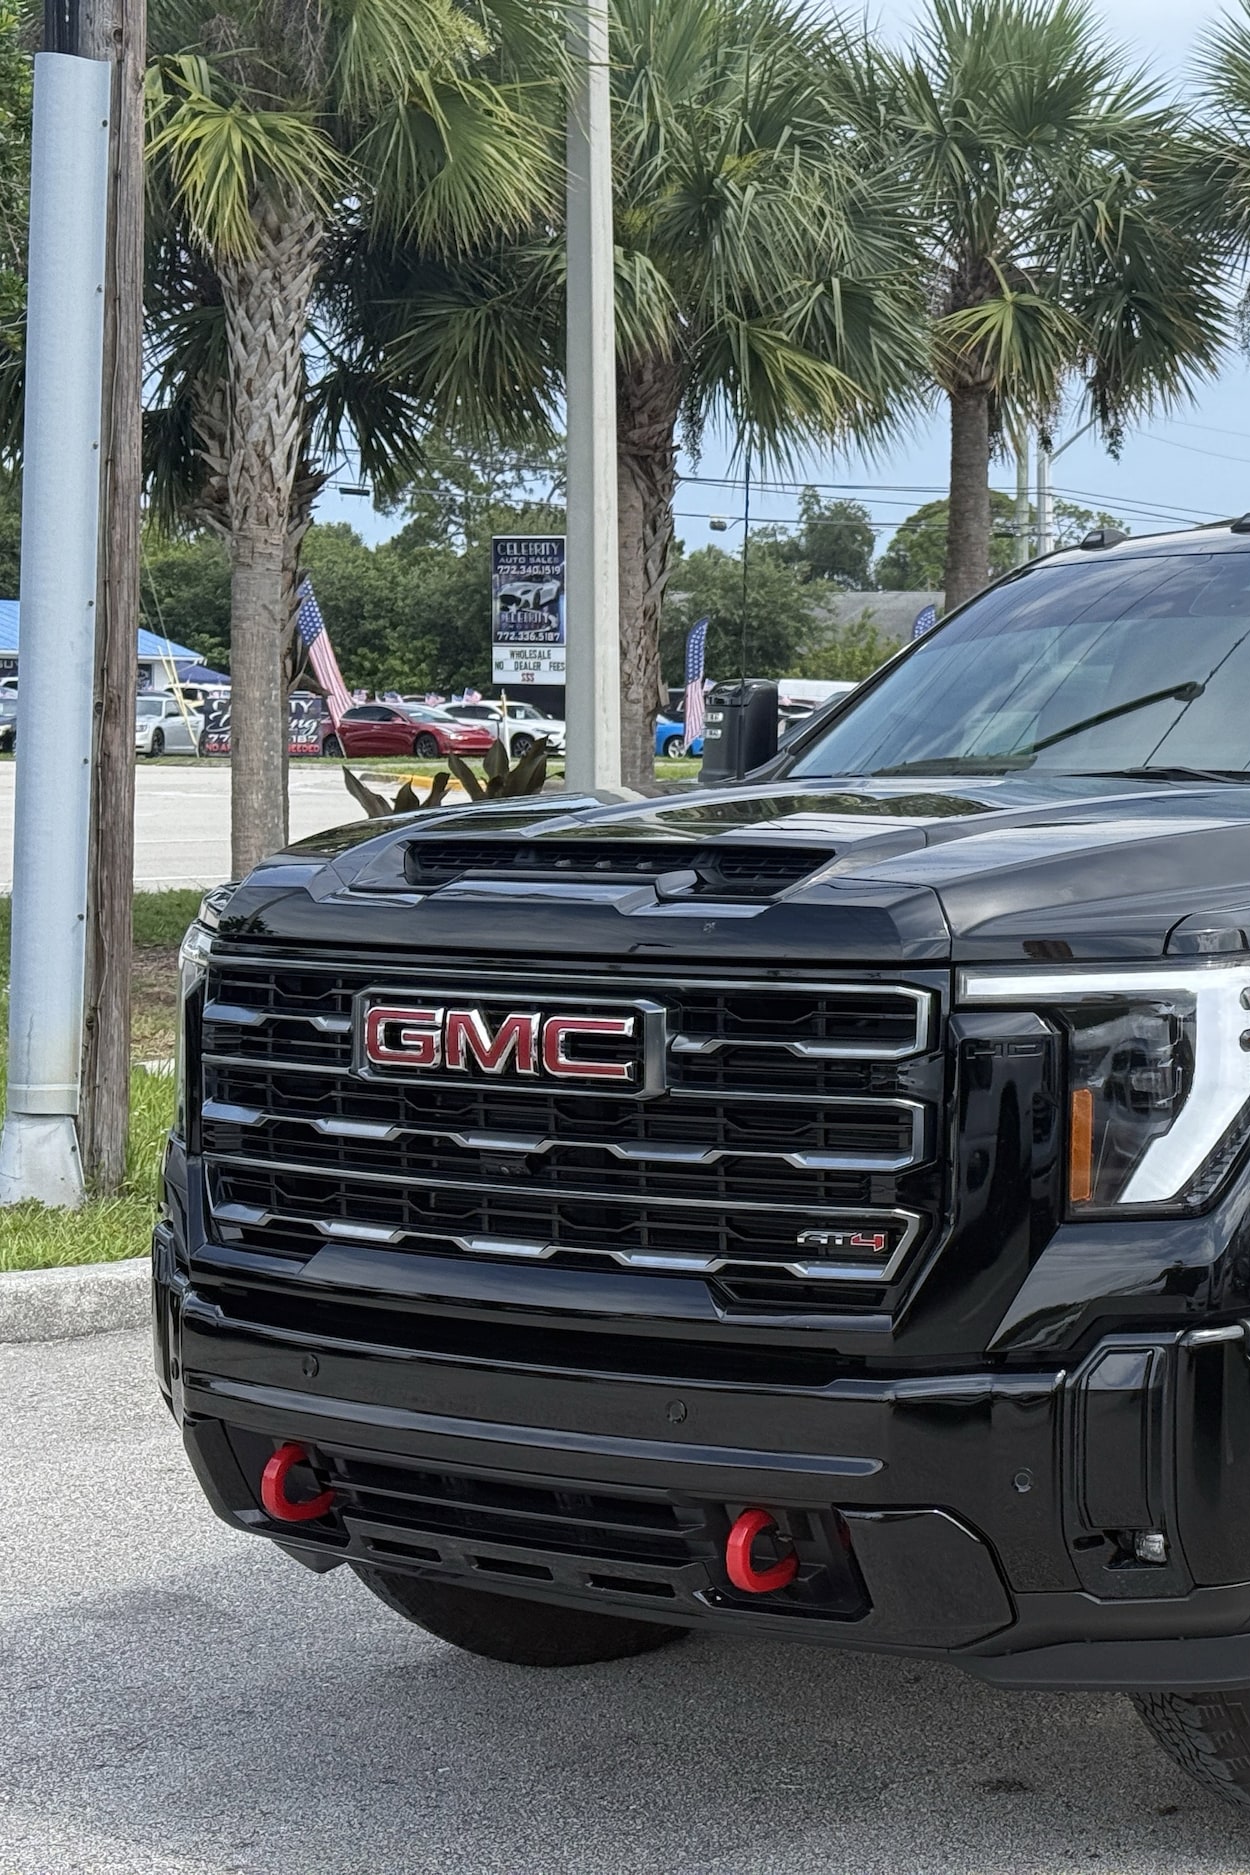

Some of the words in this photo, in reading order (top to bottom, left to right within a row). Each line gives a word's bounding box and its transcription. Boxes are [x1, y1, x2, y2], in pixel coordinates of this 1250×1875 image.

[497, 542, 560, 556] CELEBRITY
[499, 556, 526, 564] AUTO
[529, 556, 560, 564] SALES
[509, 649, 552, 660] WHOLESALE
[494, 661, 504, 671] NO
[514, 661, 542, 671] DEALER
[548, 661, 566, 671] FEES
[288, 744, 320, 753] EEDED
[364, 1006, 635, 1082] GMC
[797, 1230, 885, 1252] AT4
